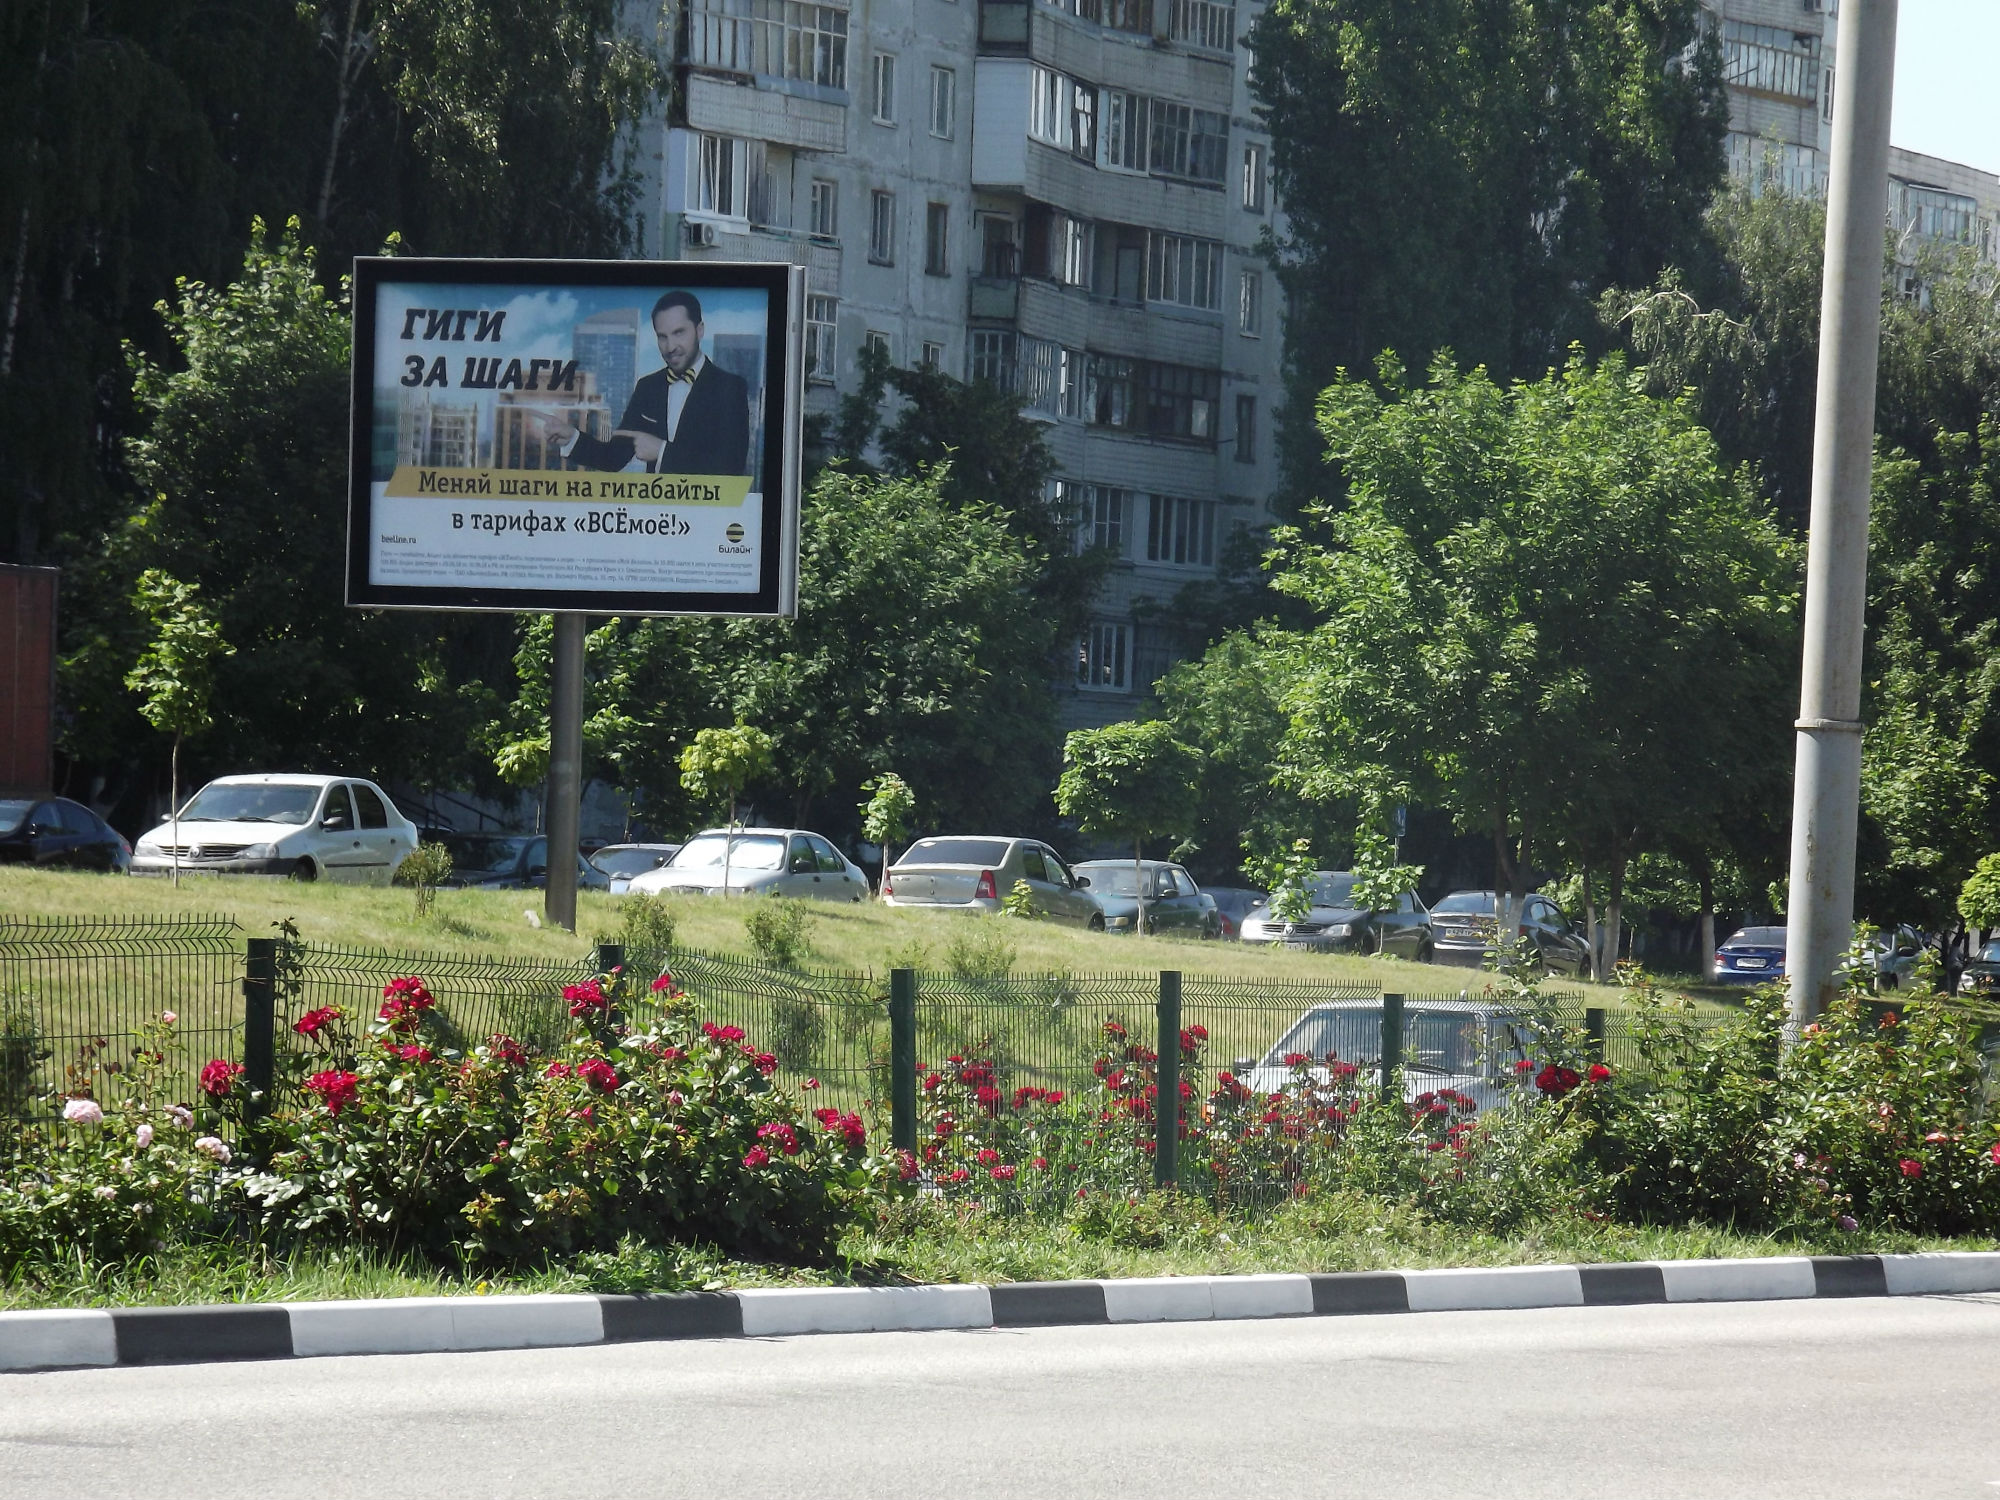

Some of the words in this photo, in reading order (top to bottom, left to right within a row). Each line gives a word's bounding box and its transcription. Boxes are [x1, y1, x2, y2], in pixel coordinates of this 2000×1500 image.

[400, 309, 506, 342] ГИГИ
[400, 355, 449, 388] ЗА
[460, 357, 579, 391] ШАГИ
[417, 471, 491, 495] Меняй
[499, 479, 558, 497] шаги
[566, 481, 593, 498] на
[600, 477, 721, 501] гигабайты
[452, 513, 464, 529] в
[471, 509, 566, 536] тарифах
[573, 507, 691, 536] «ВСЁмоё!»
[381, 534, 417, 544] beeline.ru
